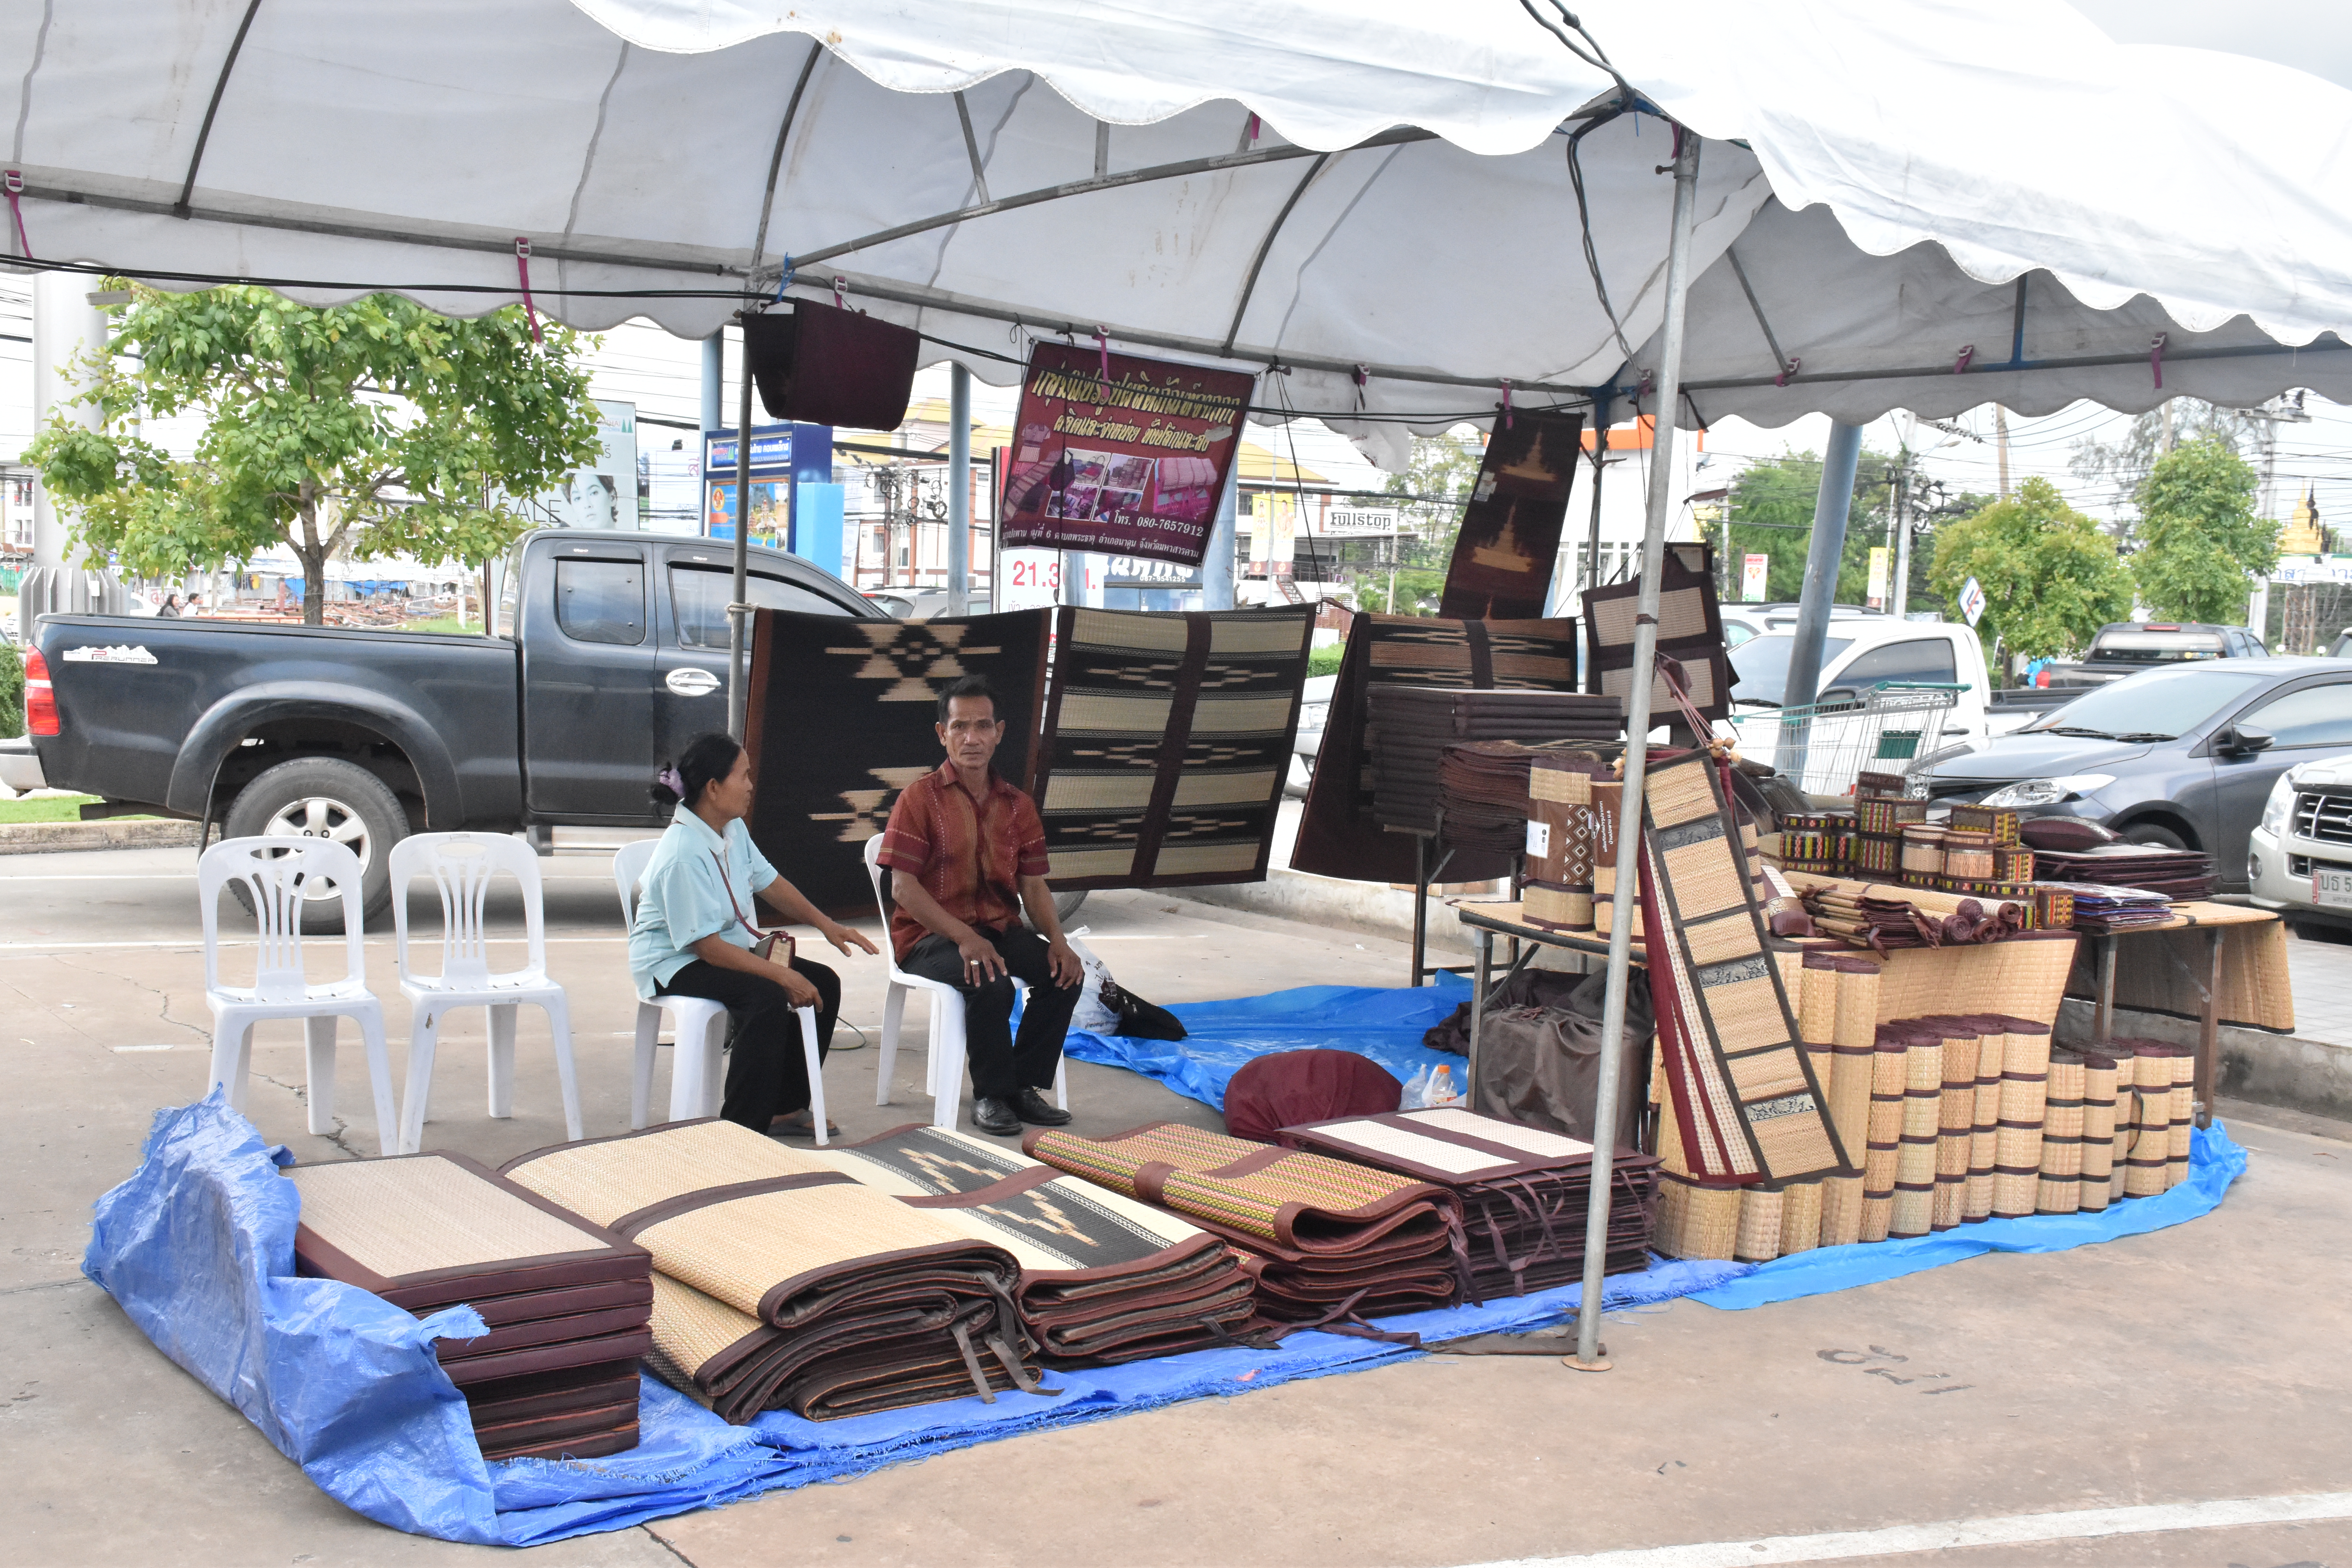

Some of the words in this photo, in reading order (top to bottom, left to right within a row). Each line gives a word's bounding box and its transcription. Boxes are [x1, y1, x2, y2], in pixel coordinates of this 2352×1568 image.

[1141, 417, 1210, 452] ทั้งปลีกและสง
[1114, 509, 1131, 525] โทร.
[1137, 516, 1204, 537] 080-7657912
[1046, 530, 1052, 538] 6
[1099, 533, 1137, 550] อำเภอนาดูน
[1140, 537, 1200, 558] จังหวัดมหาสารคาม
[1013, 560, 1065, 588] 21.3
[91, 650, 155, 663] PRERUNNER
